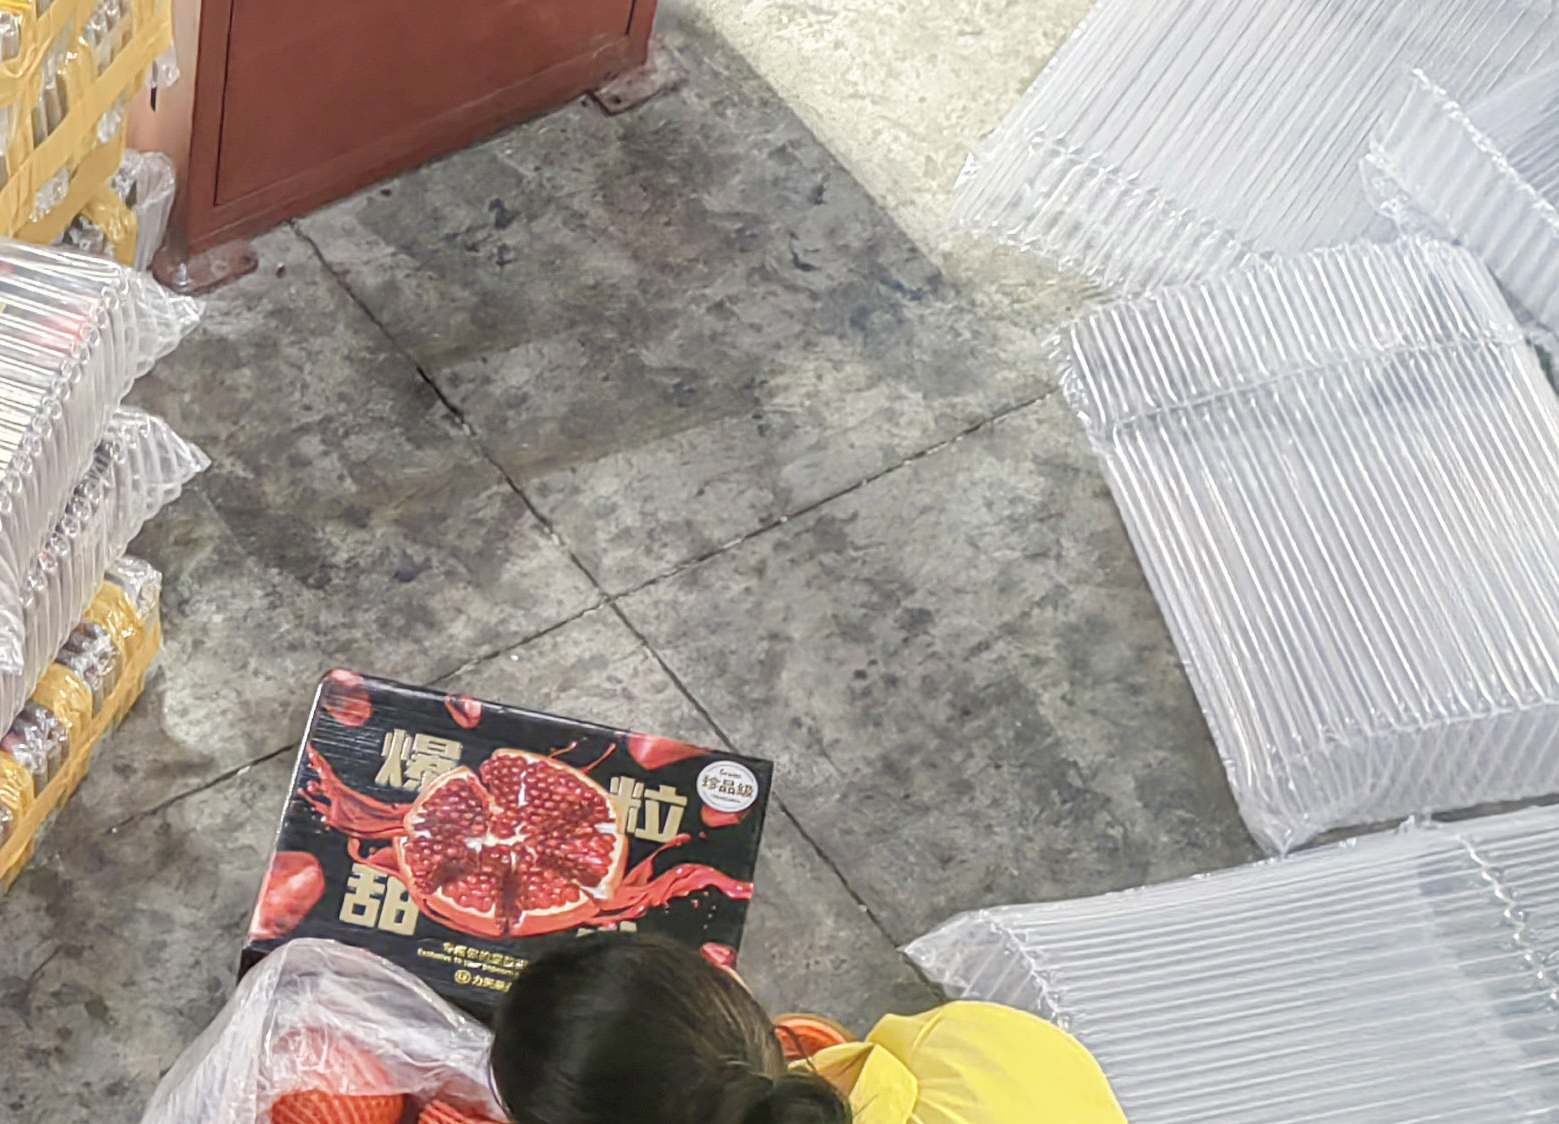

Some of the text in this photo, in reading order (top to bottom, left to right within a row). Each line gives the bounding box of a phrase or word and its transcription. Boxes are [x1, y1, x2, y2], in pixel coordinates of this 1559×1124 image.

[374, 728, 689, 844] 爆 粒
[339, 863, 420, 937] 甜
